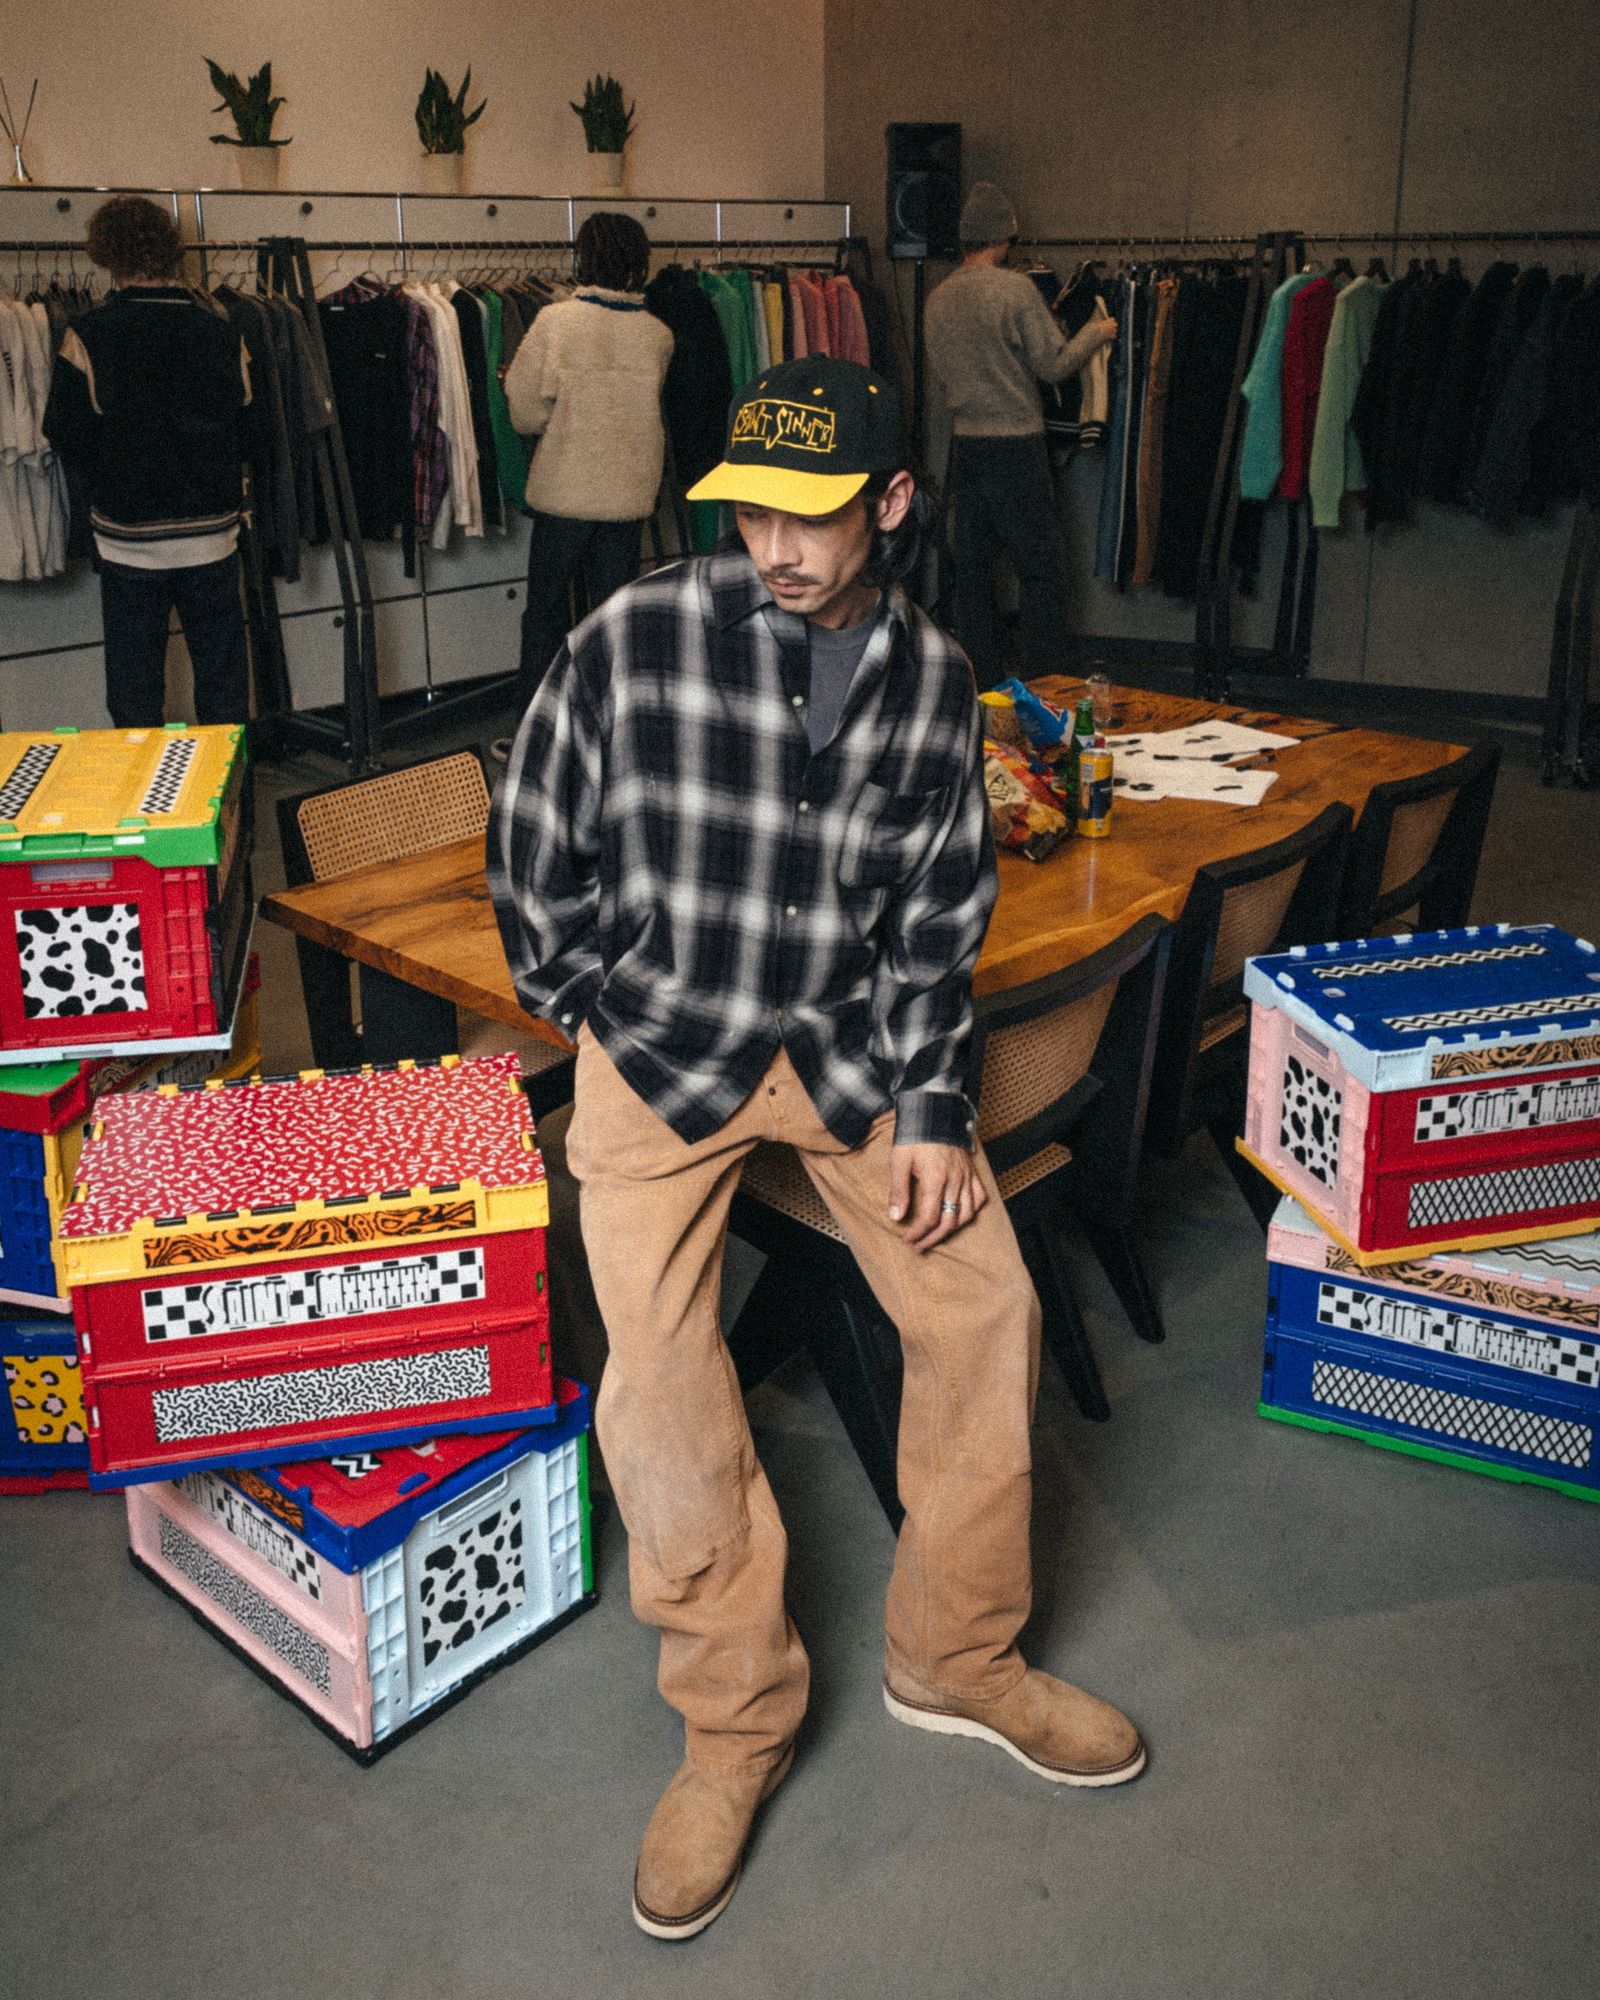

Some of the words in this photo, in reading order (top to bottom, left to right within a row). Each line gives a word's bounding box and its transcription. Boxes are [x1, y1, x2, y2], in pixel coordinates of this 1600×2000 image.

[764, 406, 832, 450] SINNER
[1458, 1091, 1519, 1133] SAINT
[201, 1280, 291, 1330] SAINT
[1363, 1295, 1435, 1345] SAINT
